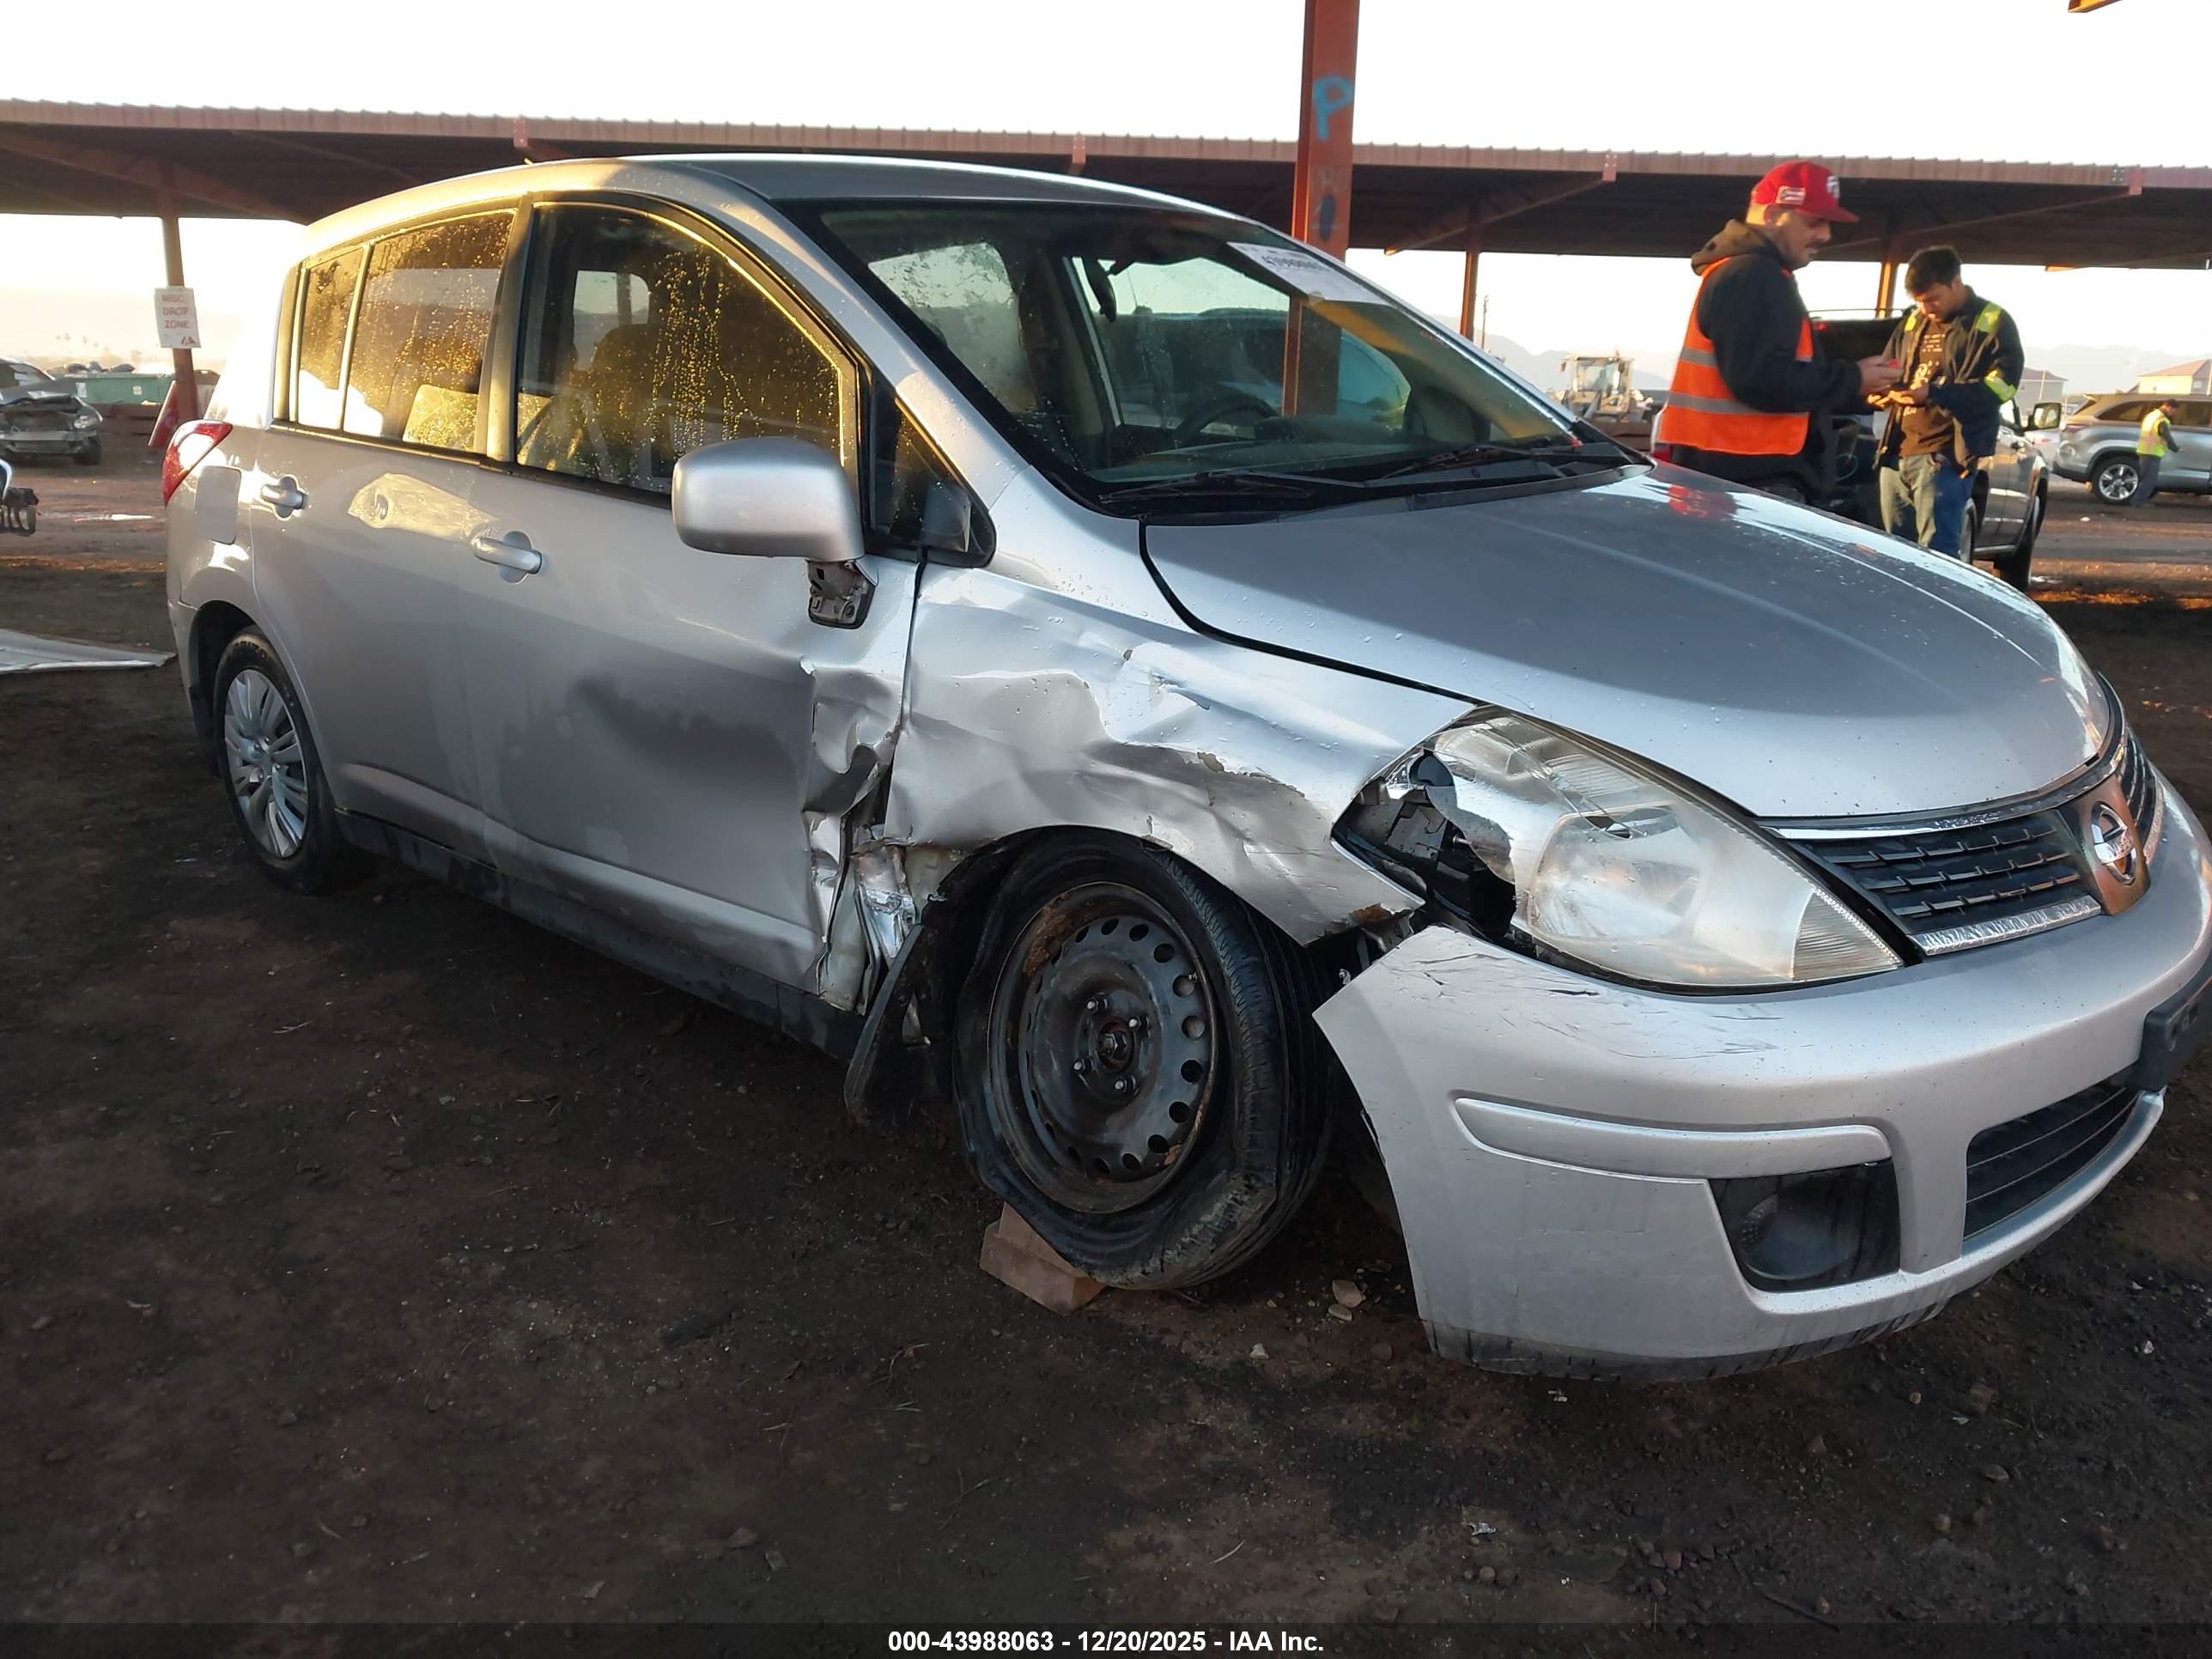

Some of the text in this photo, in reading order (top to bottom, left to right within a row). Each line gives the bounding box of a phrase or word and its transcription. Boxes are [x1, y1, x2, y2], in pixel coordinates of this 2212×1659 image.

[1313, 75, 1353, 141] P
[163, 307, 190, 316] DROP
[164, 319, 190, 329] ZONE
